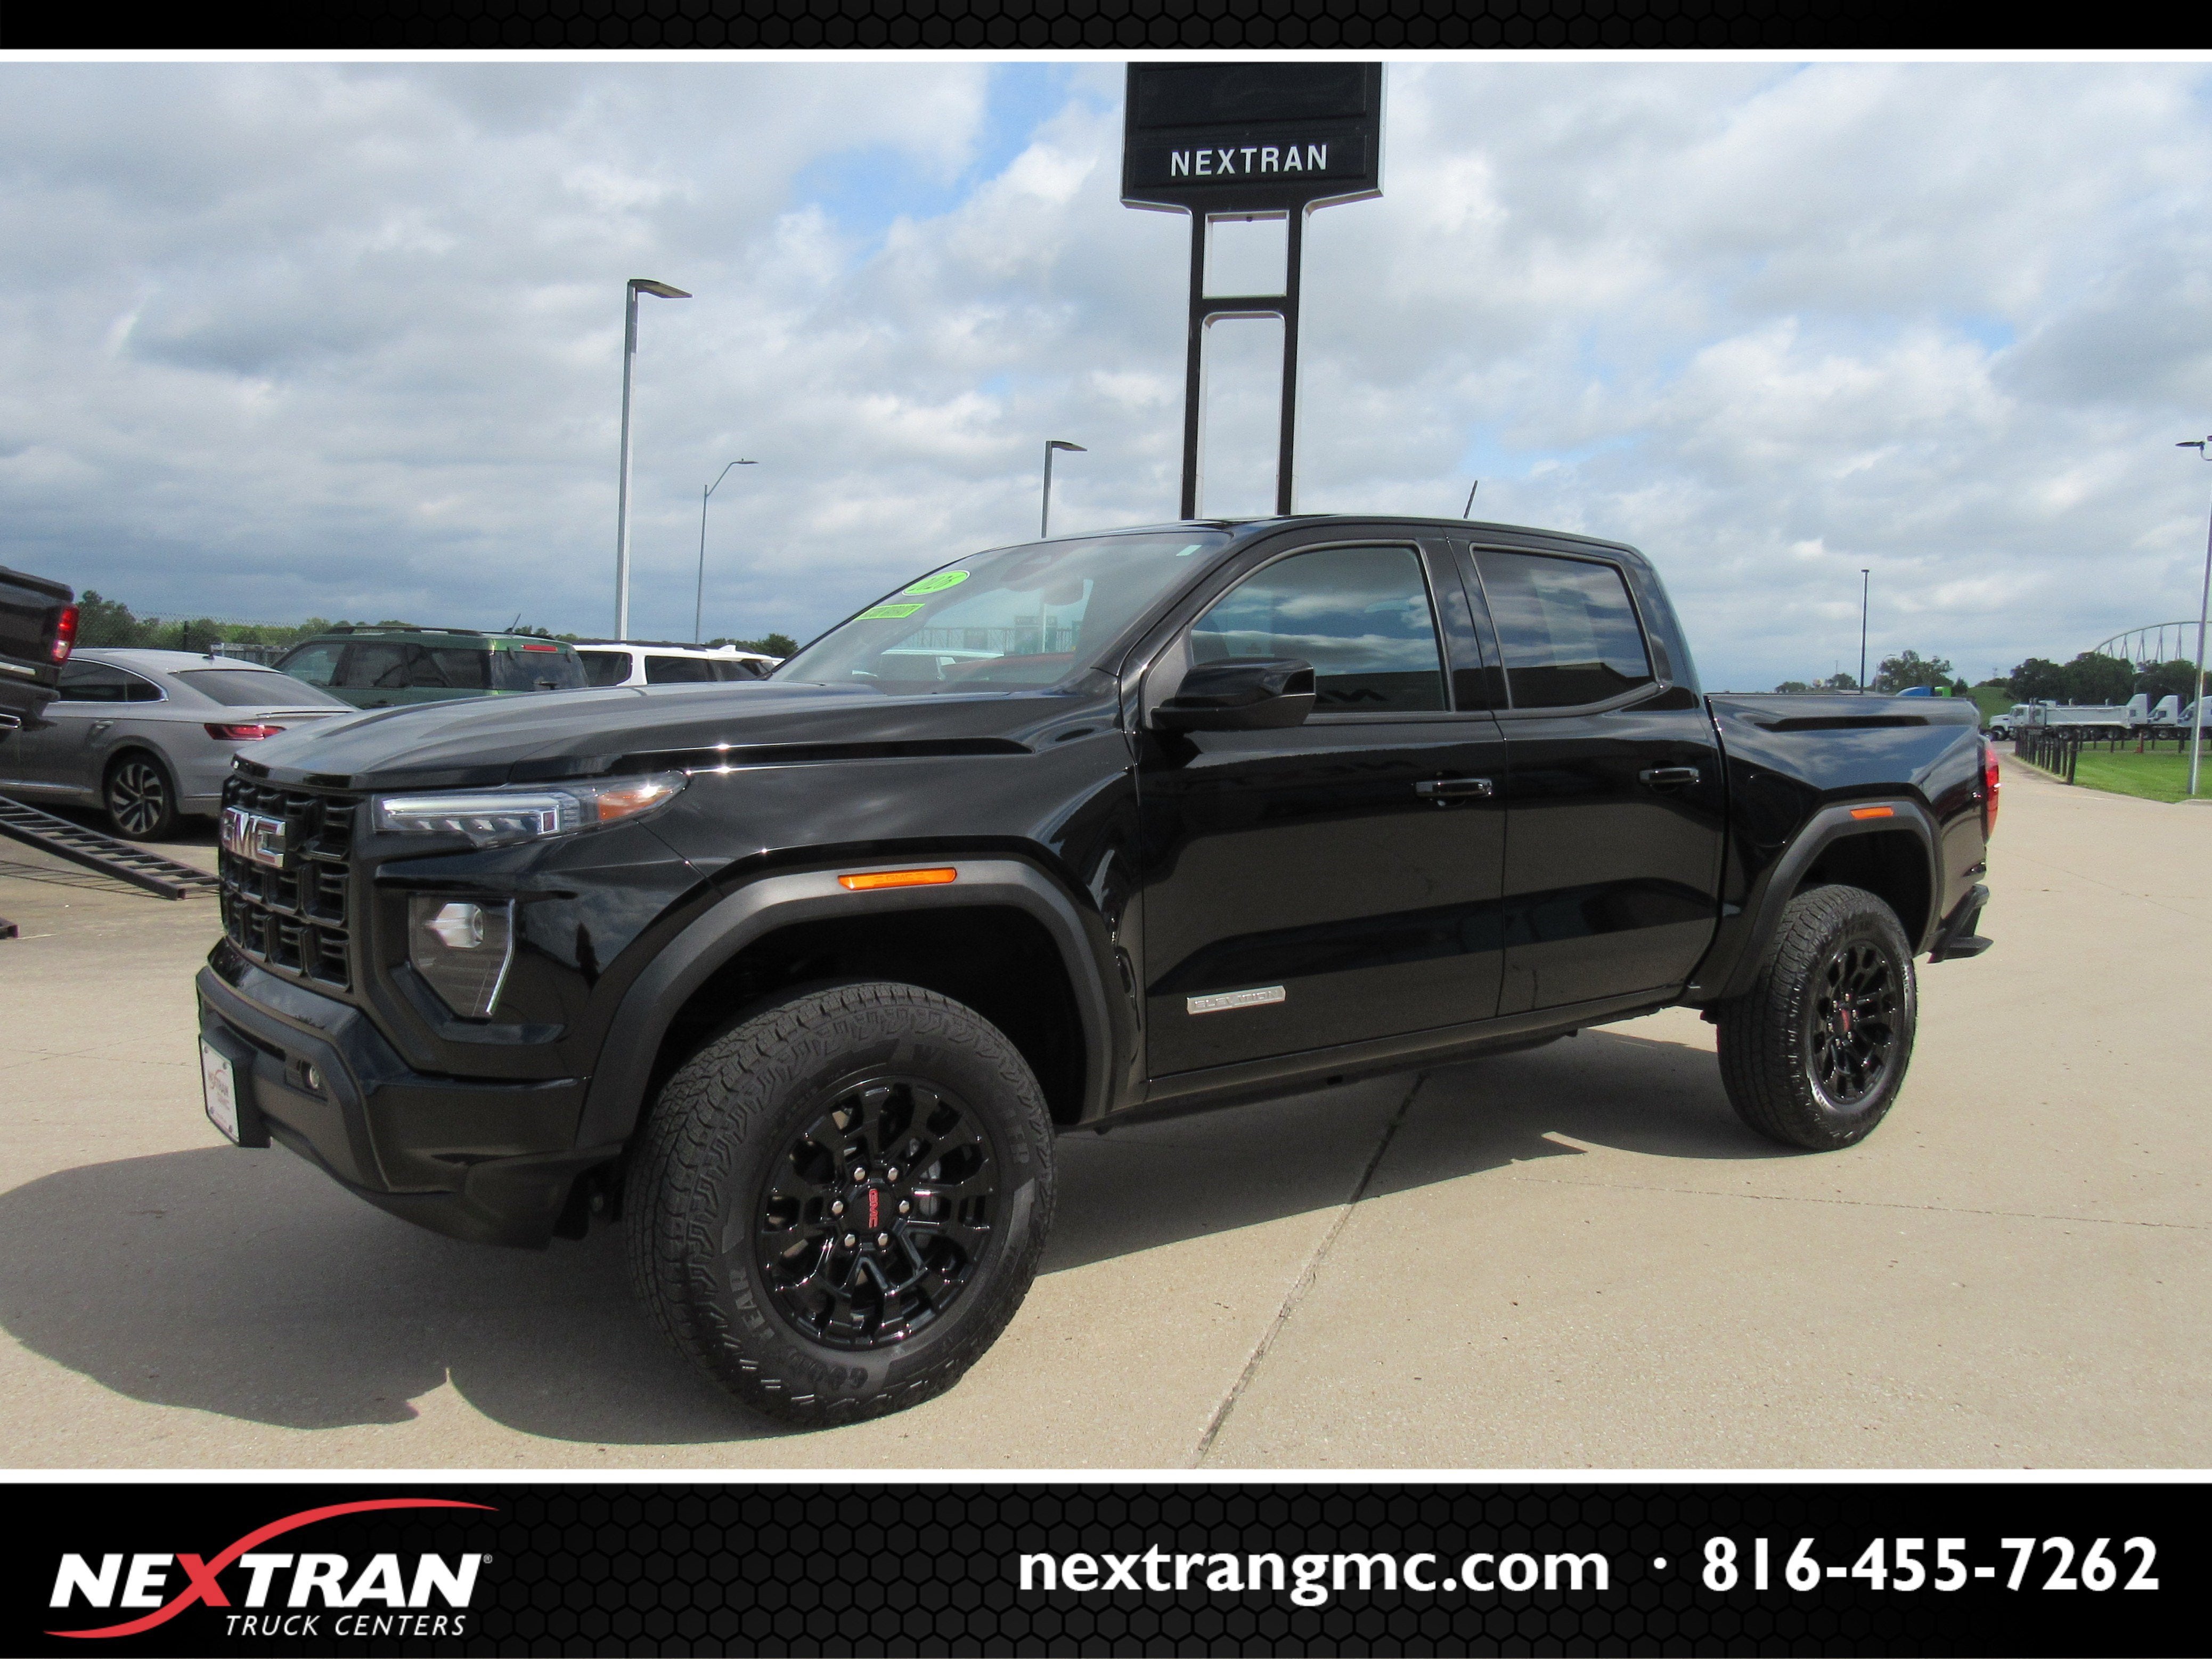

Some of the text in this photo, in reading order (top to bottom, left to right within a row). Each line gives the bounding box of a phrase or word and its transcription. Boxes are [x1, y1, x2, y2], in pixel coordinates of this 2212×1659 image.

[1171, 144, 1328, 177] NEXTRAN
[221, 807, 287, 868] GMC
[869, 1188, 879, 1229] GMC
